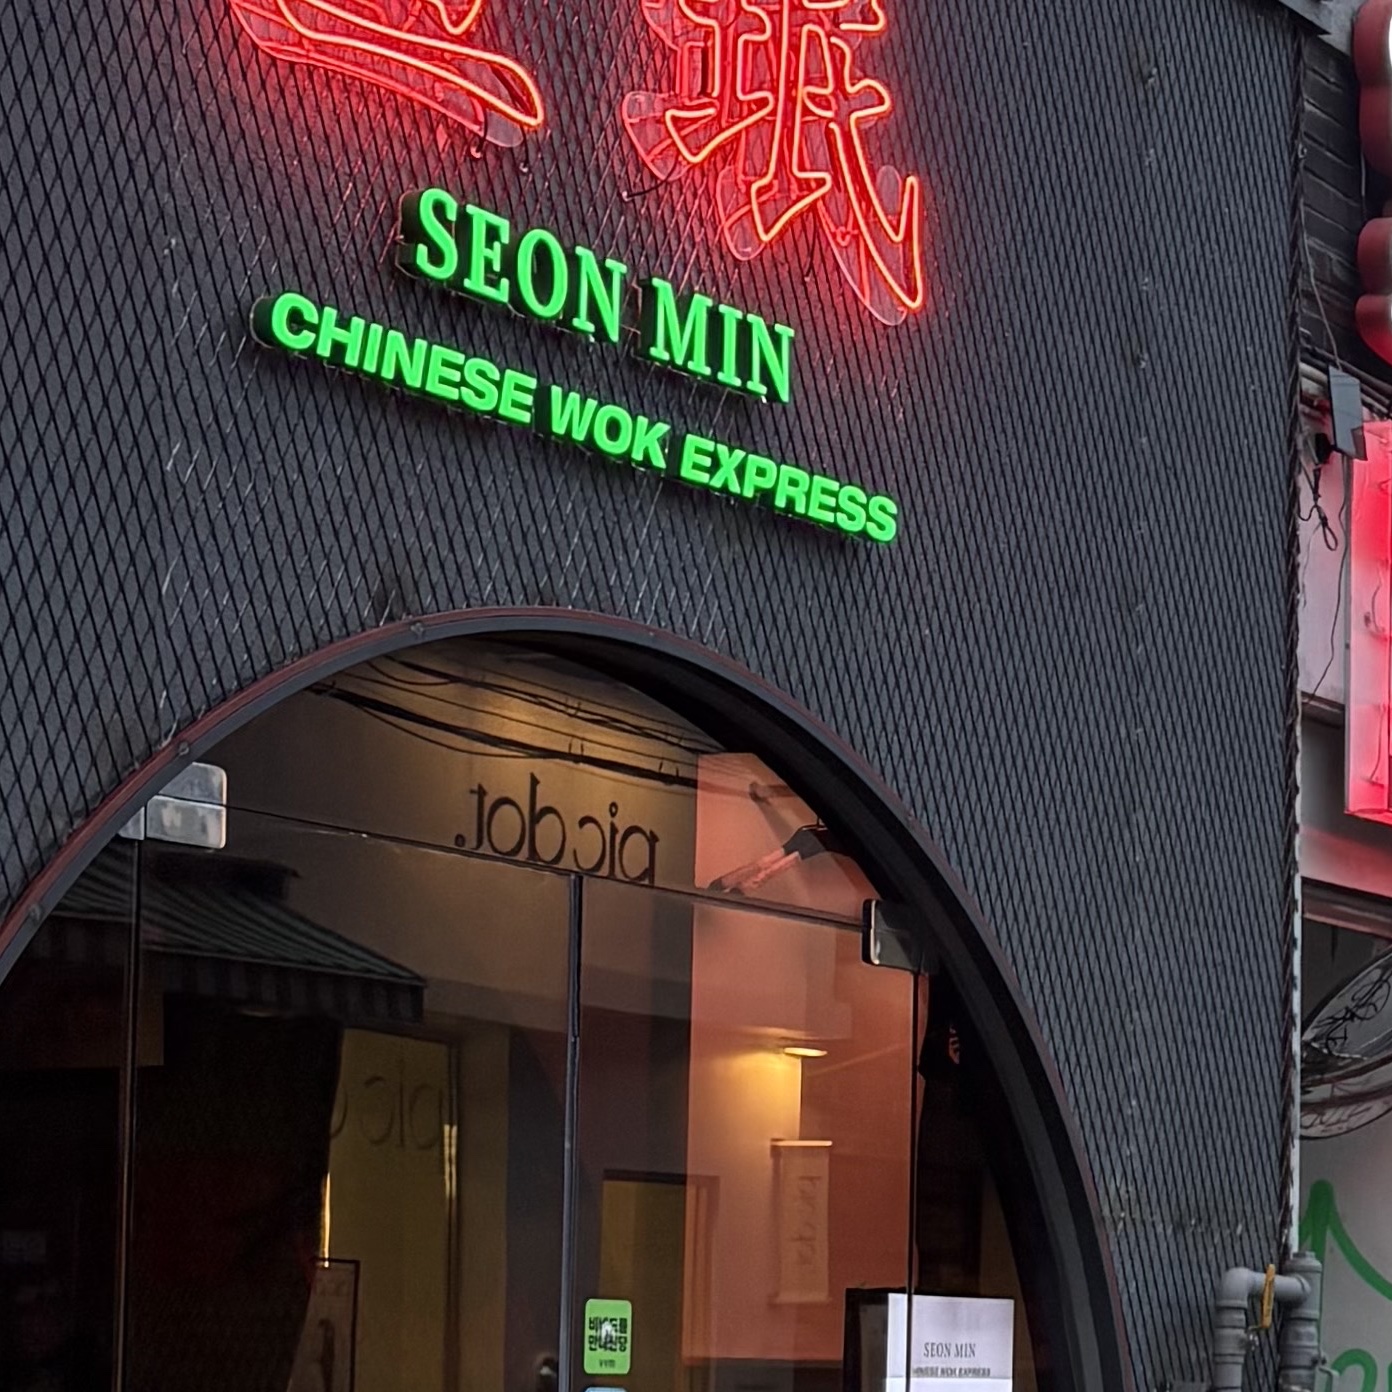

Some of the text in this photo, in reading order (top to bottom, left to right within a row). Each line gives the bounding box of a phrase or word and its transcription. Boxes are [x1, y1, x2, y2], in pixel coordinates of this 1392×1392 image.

[415, 187, 796, 404] SEON MIN
[269, 291, 899, 544] CHINESE WOK EXPRESS
[923, 1342, 976, 1358] SEON MIN
